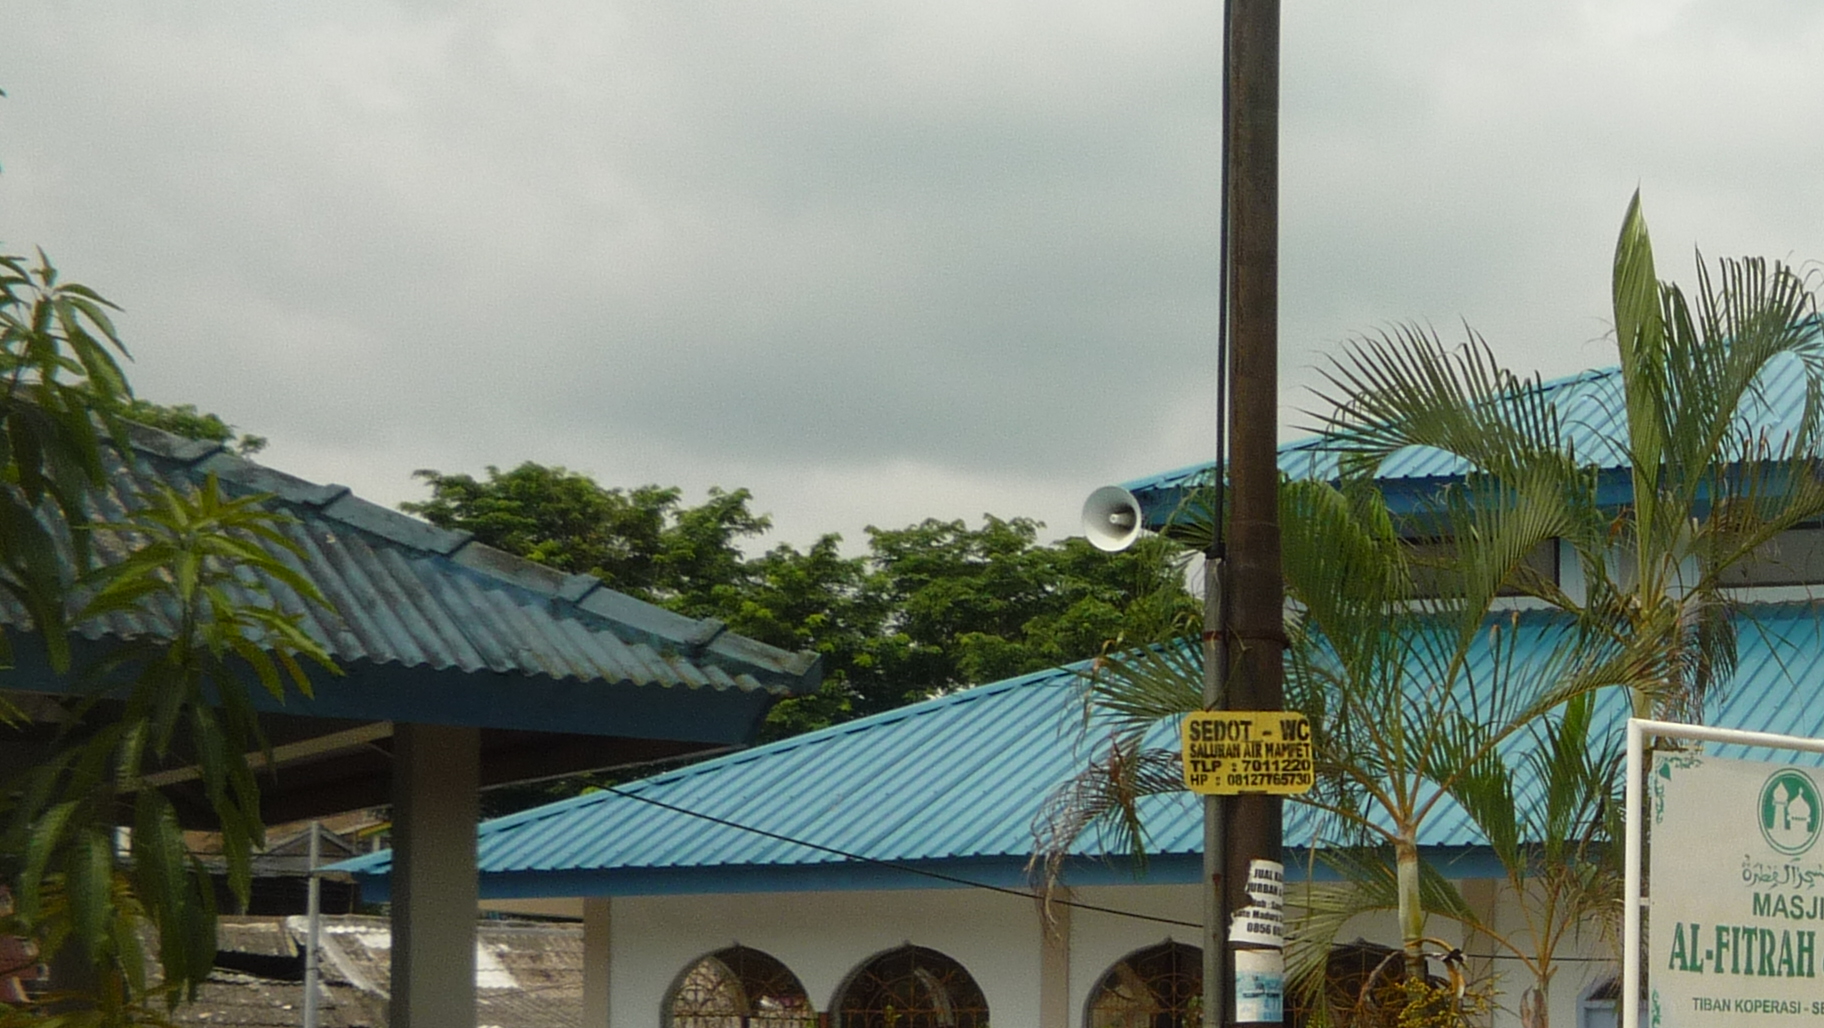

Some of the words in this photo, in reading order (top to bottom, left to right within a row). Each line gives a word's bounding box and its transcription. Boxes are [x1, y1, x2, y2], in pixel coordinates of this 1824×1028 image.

[1189, 719, 1252, 741] SEDOT
[1280, 719, 1310, 740] WC
[1189, 743, 1240, 758] SALURAN
[1243, 743, 1262, 758] AIR
[1189, 760, 1222, 772] TLP
[1241, 760, 1311, 772] 7011220
[1189, 774, 1208, 786] HP
[1254, 869, 1273, 880] JUAL
[1247, 922, 1271, 935] 0856
[1668, 922, 1816, 978] AL-FITRAH
[1692, 997, 1732, 1013] TIBAN
[1735, 999, 1801, 1015] KOPERASI
